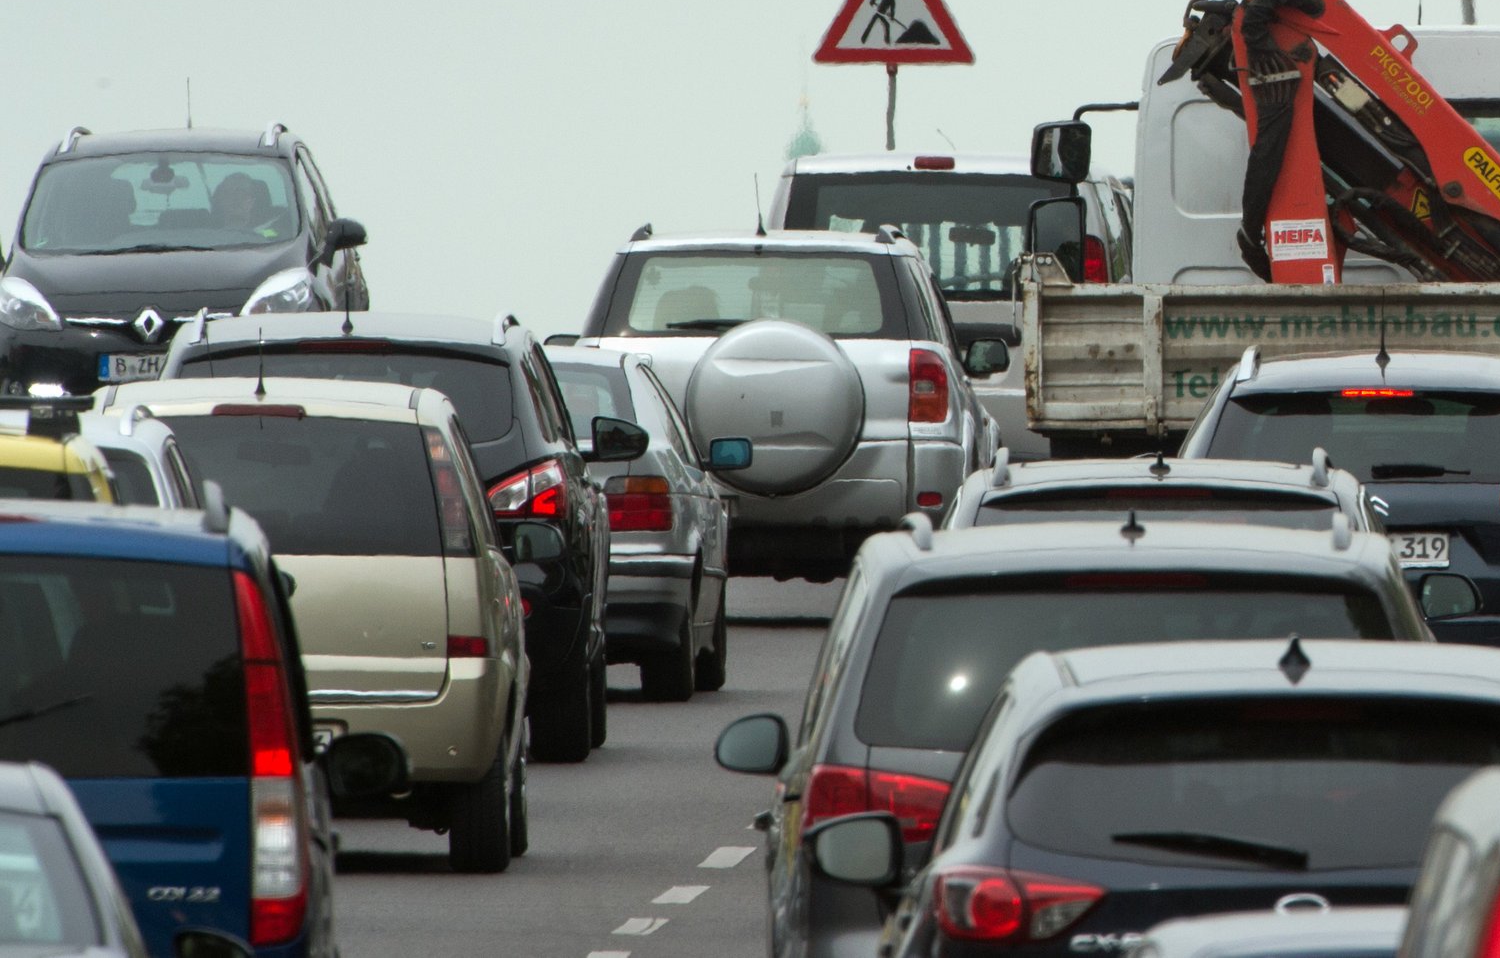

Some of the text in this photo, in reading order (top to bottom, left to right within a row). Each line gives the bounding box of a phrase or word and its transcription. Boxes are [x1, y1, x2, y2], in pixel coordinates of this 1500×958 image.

[1370, 45, 1402, 77] PKG
[1274, 228, 1324, 245] HEIFA
[1400, 537, 1446, 559] 319
